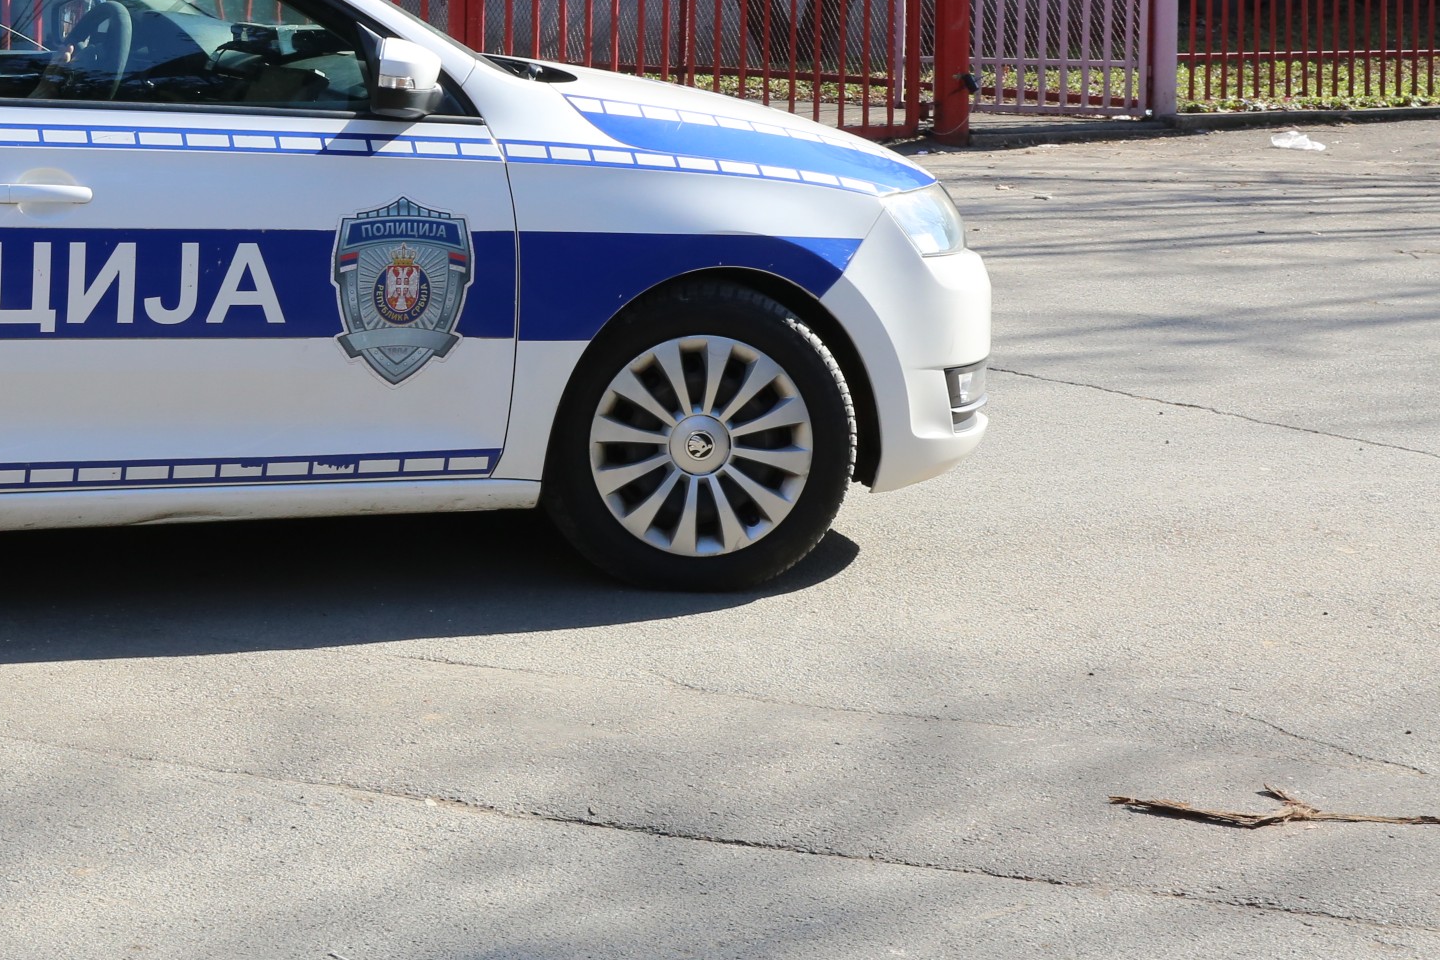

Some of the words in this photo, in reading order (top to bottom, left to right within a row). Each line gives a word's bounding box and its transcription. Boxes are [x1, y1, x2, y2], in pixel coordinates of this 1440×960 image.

[361, 222, 447, 238] ПОЛИЦИЈА
[376, 284, 409, 321] РЕПУБЛИКА
[411, 283, 428, 316] СРБИЈА
